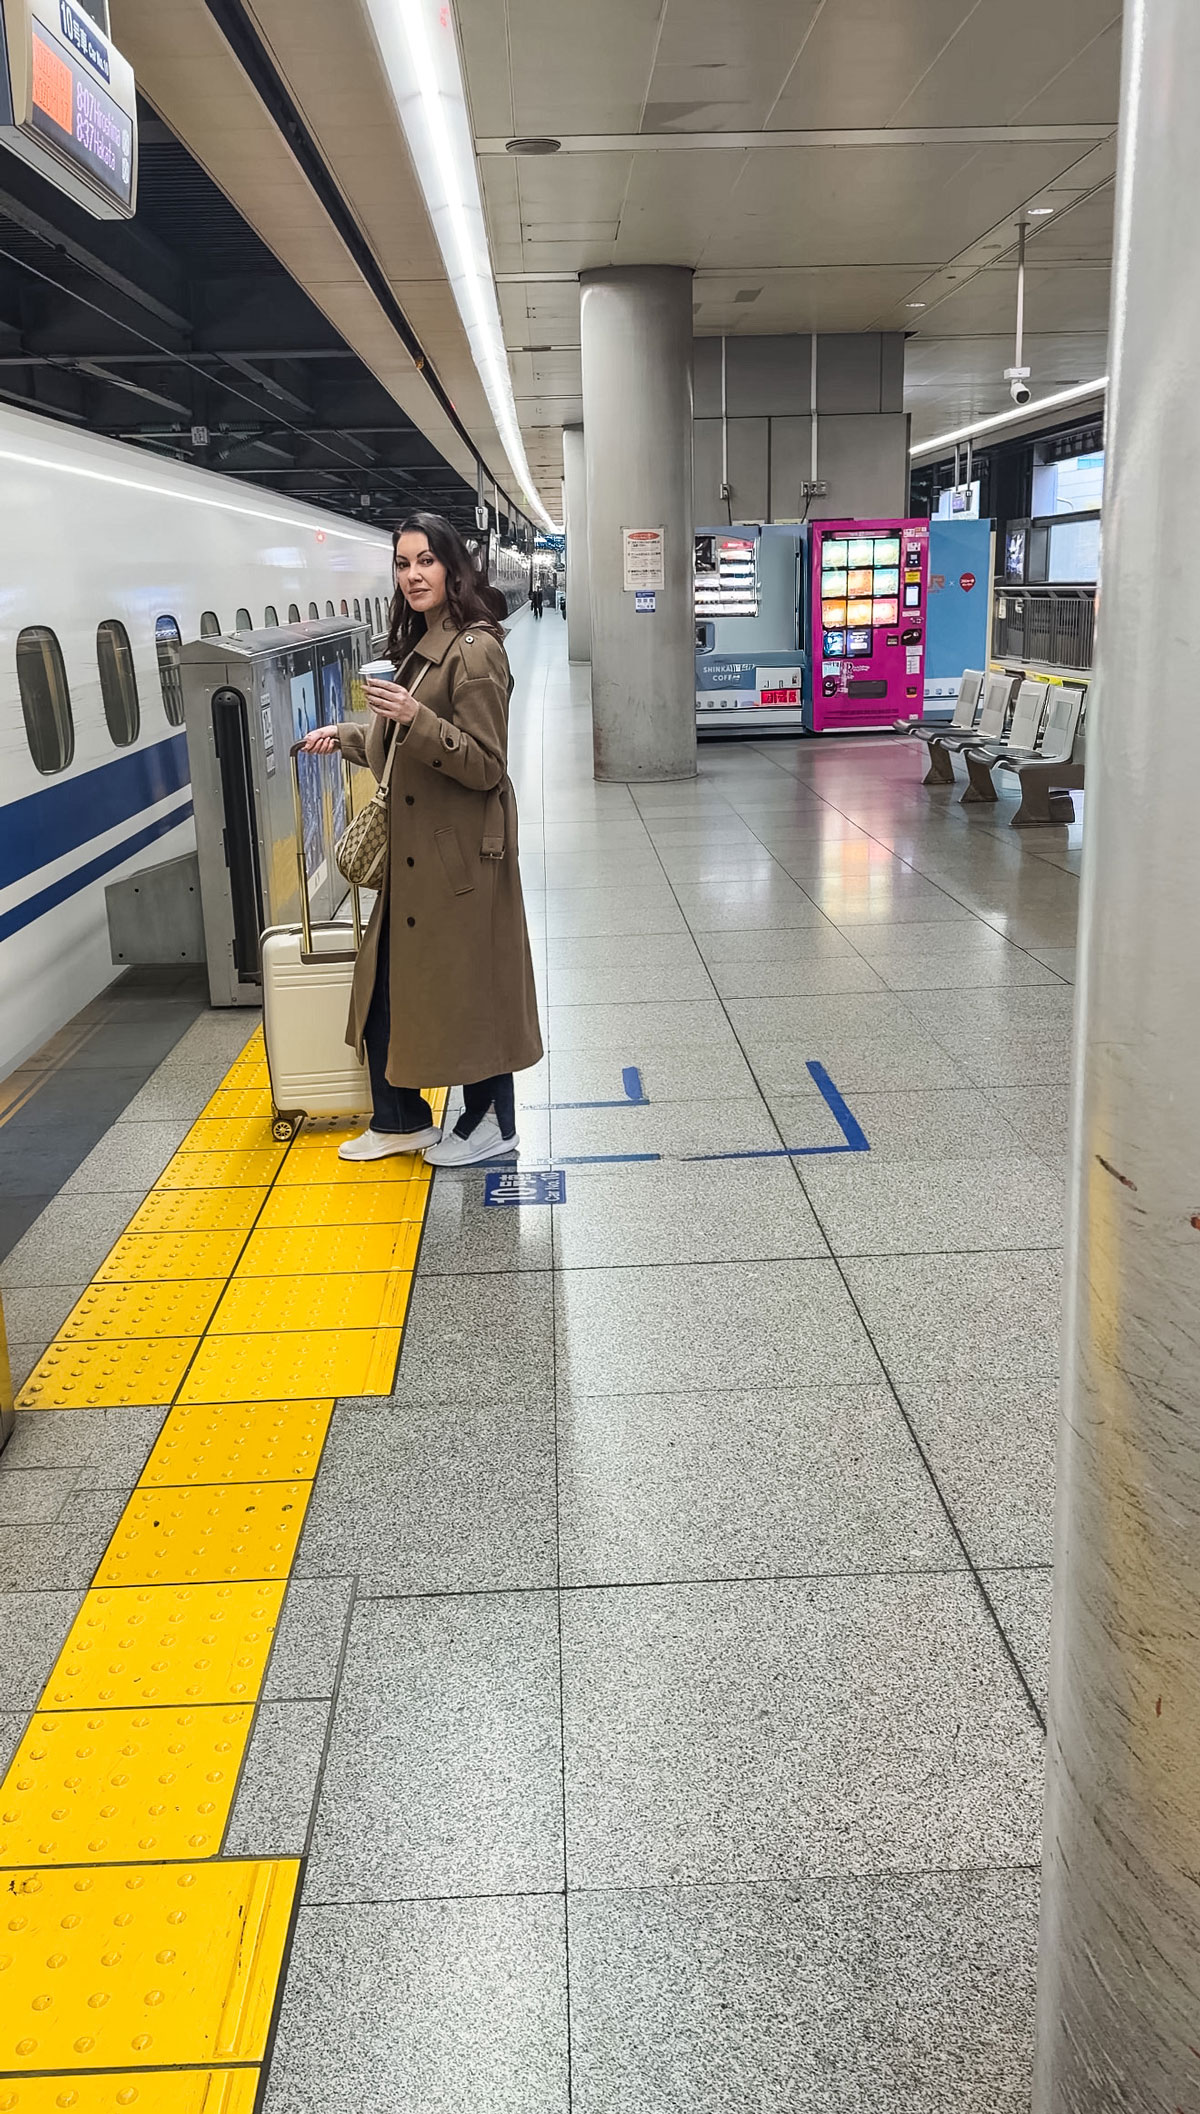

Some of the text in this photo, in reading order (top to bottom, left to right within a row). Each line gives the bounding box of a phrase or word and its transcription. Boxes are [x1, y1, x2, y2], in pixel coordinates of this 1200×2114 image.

[61, 1, 88, 54] 10号車
[93, 98, 120, 148] Hiroshima
[93, 128, 115, 171] Hakata
[490, 1174, 537, 1203] 10号車
[544, 1190, 560, 1202] Car
